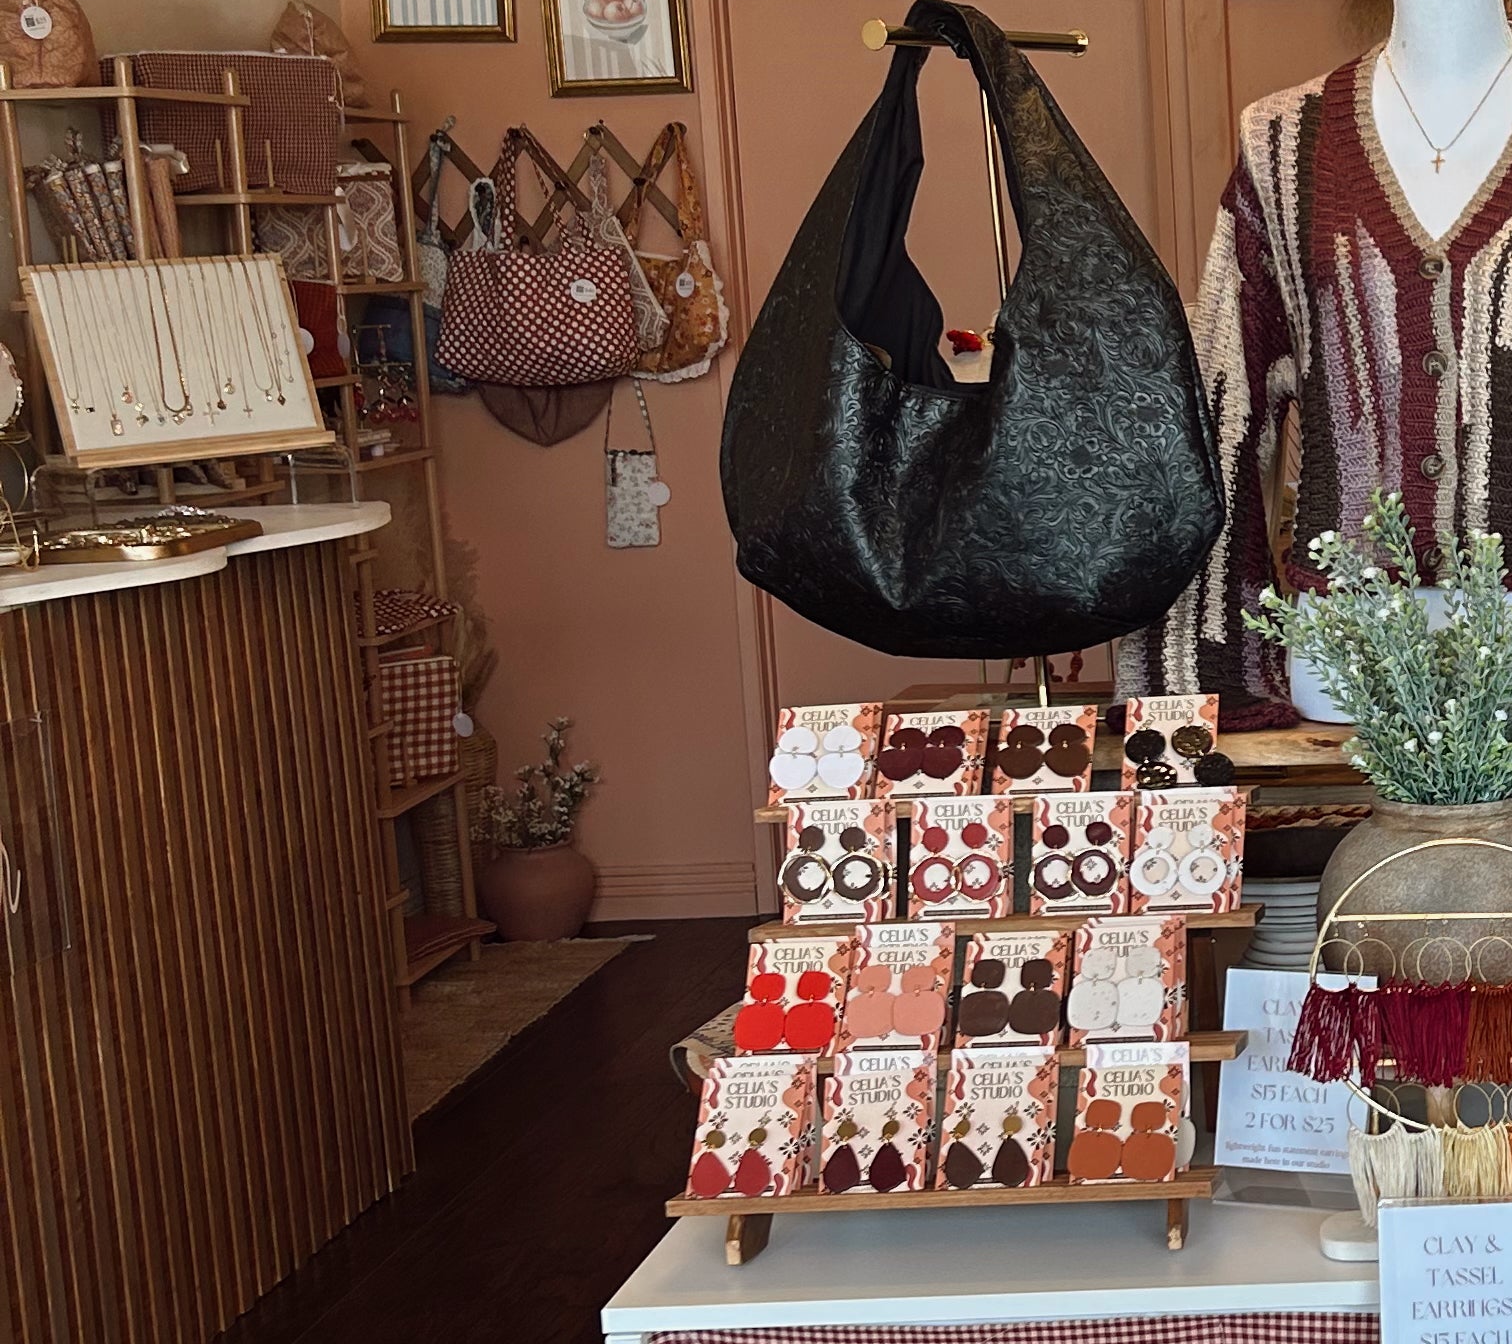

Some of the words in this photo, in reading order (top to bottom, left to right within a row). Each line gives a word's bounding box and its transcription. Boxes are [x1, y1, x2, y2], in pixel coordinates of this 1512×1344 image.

[1148, 698, 1195, 711] CELIA'S
[801, 708, 849, 722] CELIA'S
[909, 714, 956, 727] CELIA'S
[1025, 709, 1072, 721] CELIA'S
[811, 807, 860, 821] CELIA'S
[934, 804, 984, 817] CELIA'S
[1055, 799, 1105, 814] CELIA'S
[1159, 807, 1208, 821] CELIA'S
[878, 927, 929, 943] CELIA'S
[1098, 930, 1149, 945] CELIA'S
[774, 945, 825, 961] CELIA'S
[876, 949, 928, 964] CELIA'S
[990, 942, 1041, 957] CELIA'S
[772, 960, 824, 975] STUDIO
[1263, 998, 1302, 1016] CLA
[1111, 1047, 1163, 1063] CELIA'S
[859, 1056, 910, 1072] CELIA'S
[849, 1074, 902, 1092] CELIA'S
[972, 1071, 1024, 1087] CELIA'S
[1103, 1068, 1156, 1084] CELIA'S
[727, 1079, 779, 1096] CELIA'S
[970, 1085, 1023, 1100] STUDIO
[1102, 1082, 1155, 1098] STUDIO
[1281, 1086, 1328, 1104] EACH
[724, 1094, 778, 1109] STUDIO
[848, 1088, 901, 1106] STUDIO
[1245, 1112, 1256, 1128] 2
[1260, 1113, 1297, 1131] FOR
[1423, 1235, 1478, 1255] CLAY
[1485, 1234, 1504, 1254] &
[1426, 1266, 1504, 1287] TASSEL
